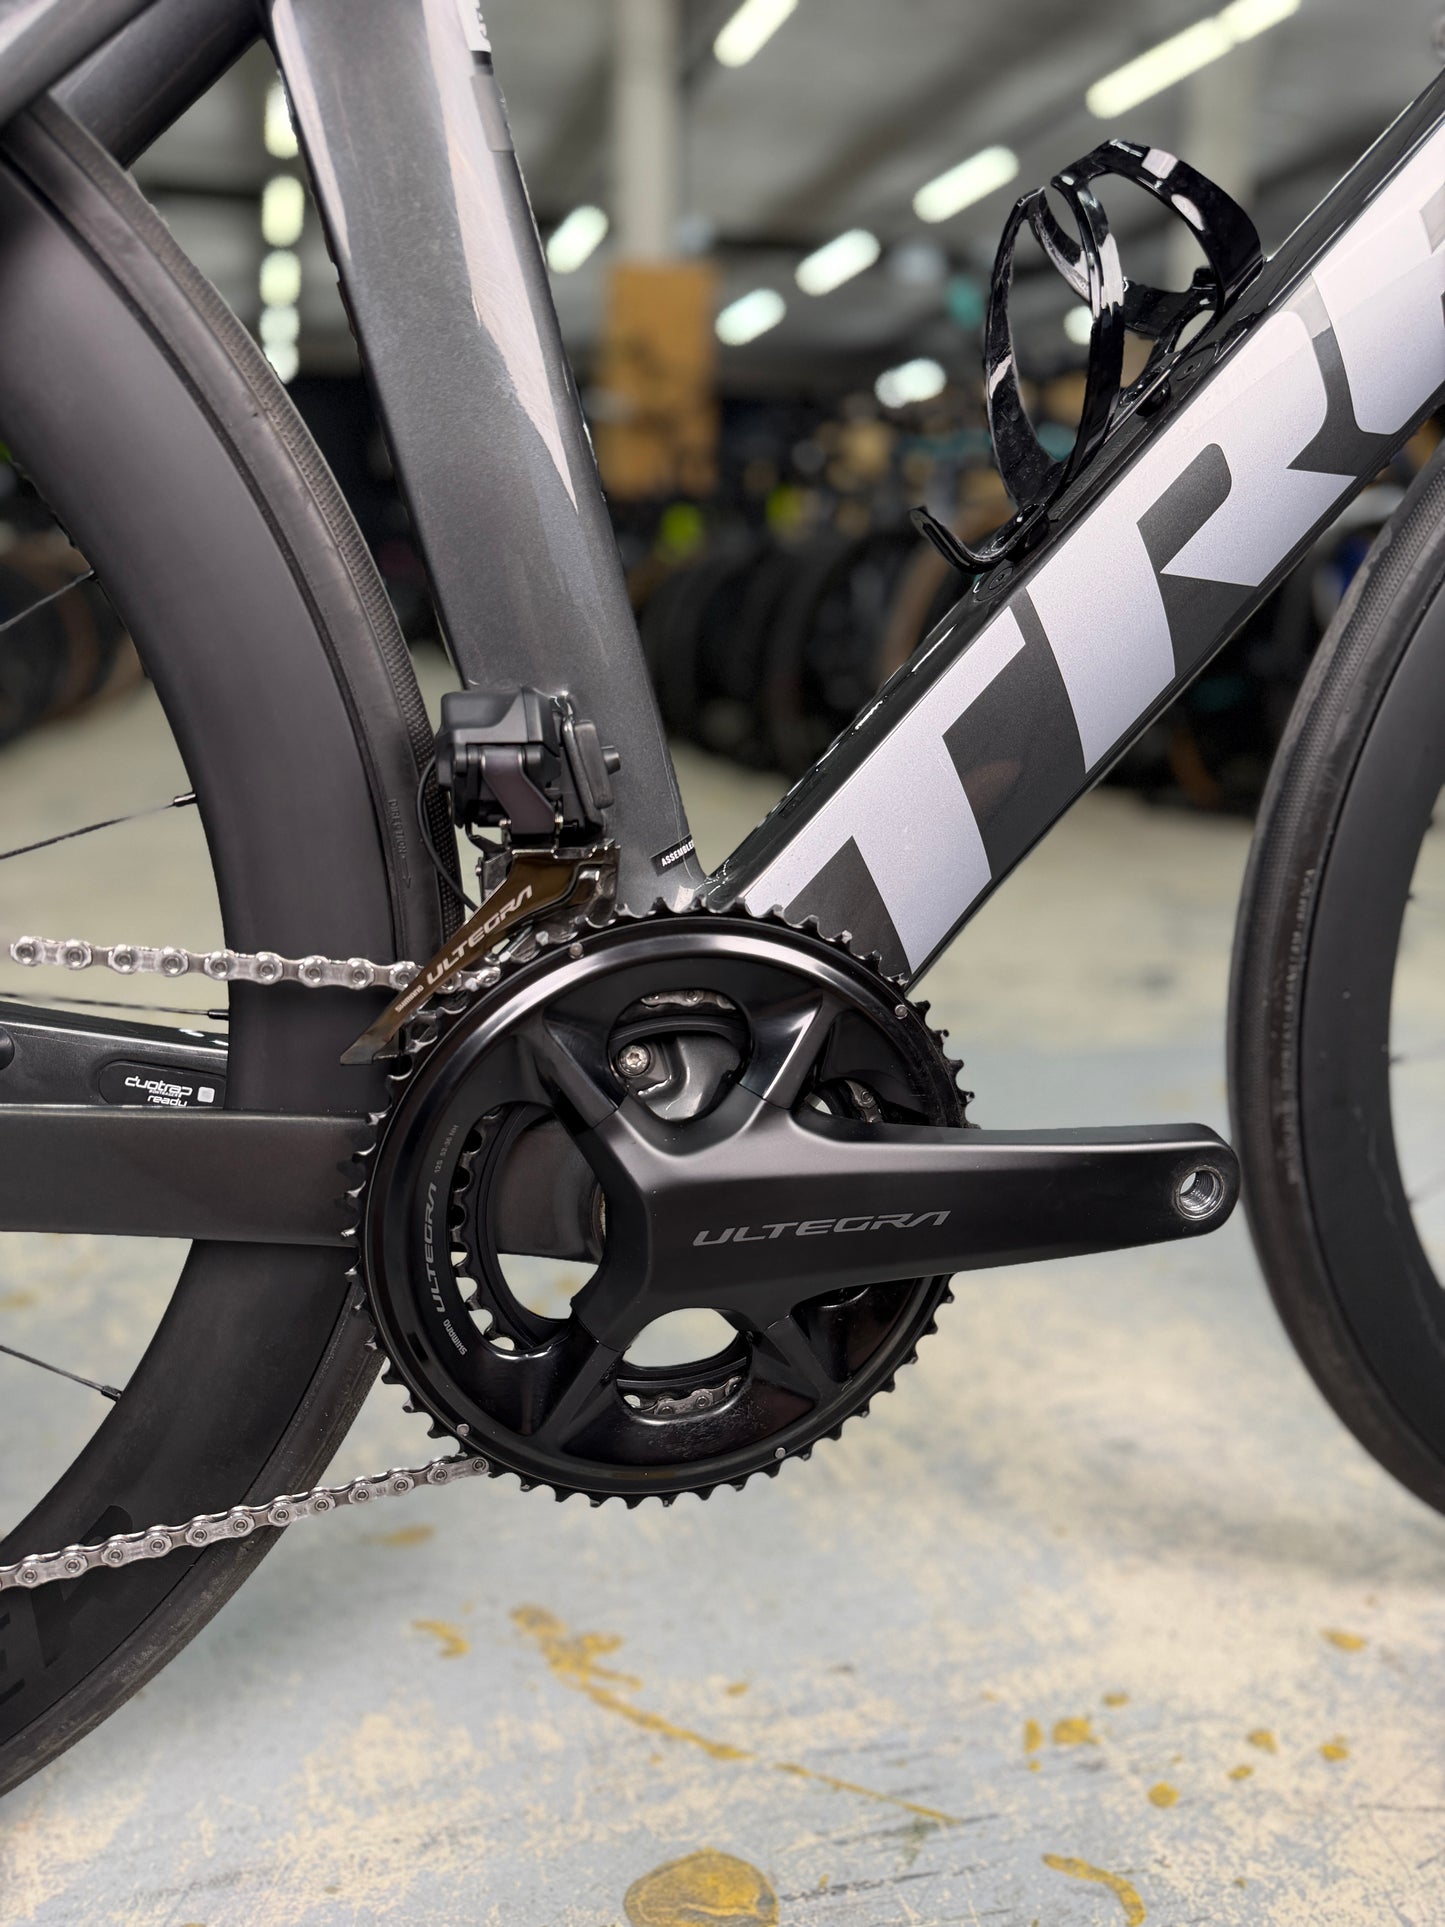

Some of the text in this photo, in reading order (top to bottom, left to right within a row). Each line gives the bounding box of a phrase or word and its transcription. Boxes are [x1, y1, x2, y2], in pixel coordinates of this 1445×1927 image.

[661, 840, 695, 867] ASSEMBLE
[395, 885, 532, 1012] SHIMANO ULTEGRA
[124, 1075, 193, 1098] duotrap
[693, 1211, 951, 1246] ULTEGRA
[424, 1182, 446, 1312] ULTEGRA
[443, 1319, 468, 1355] SHIMANO
